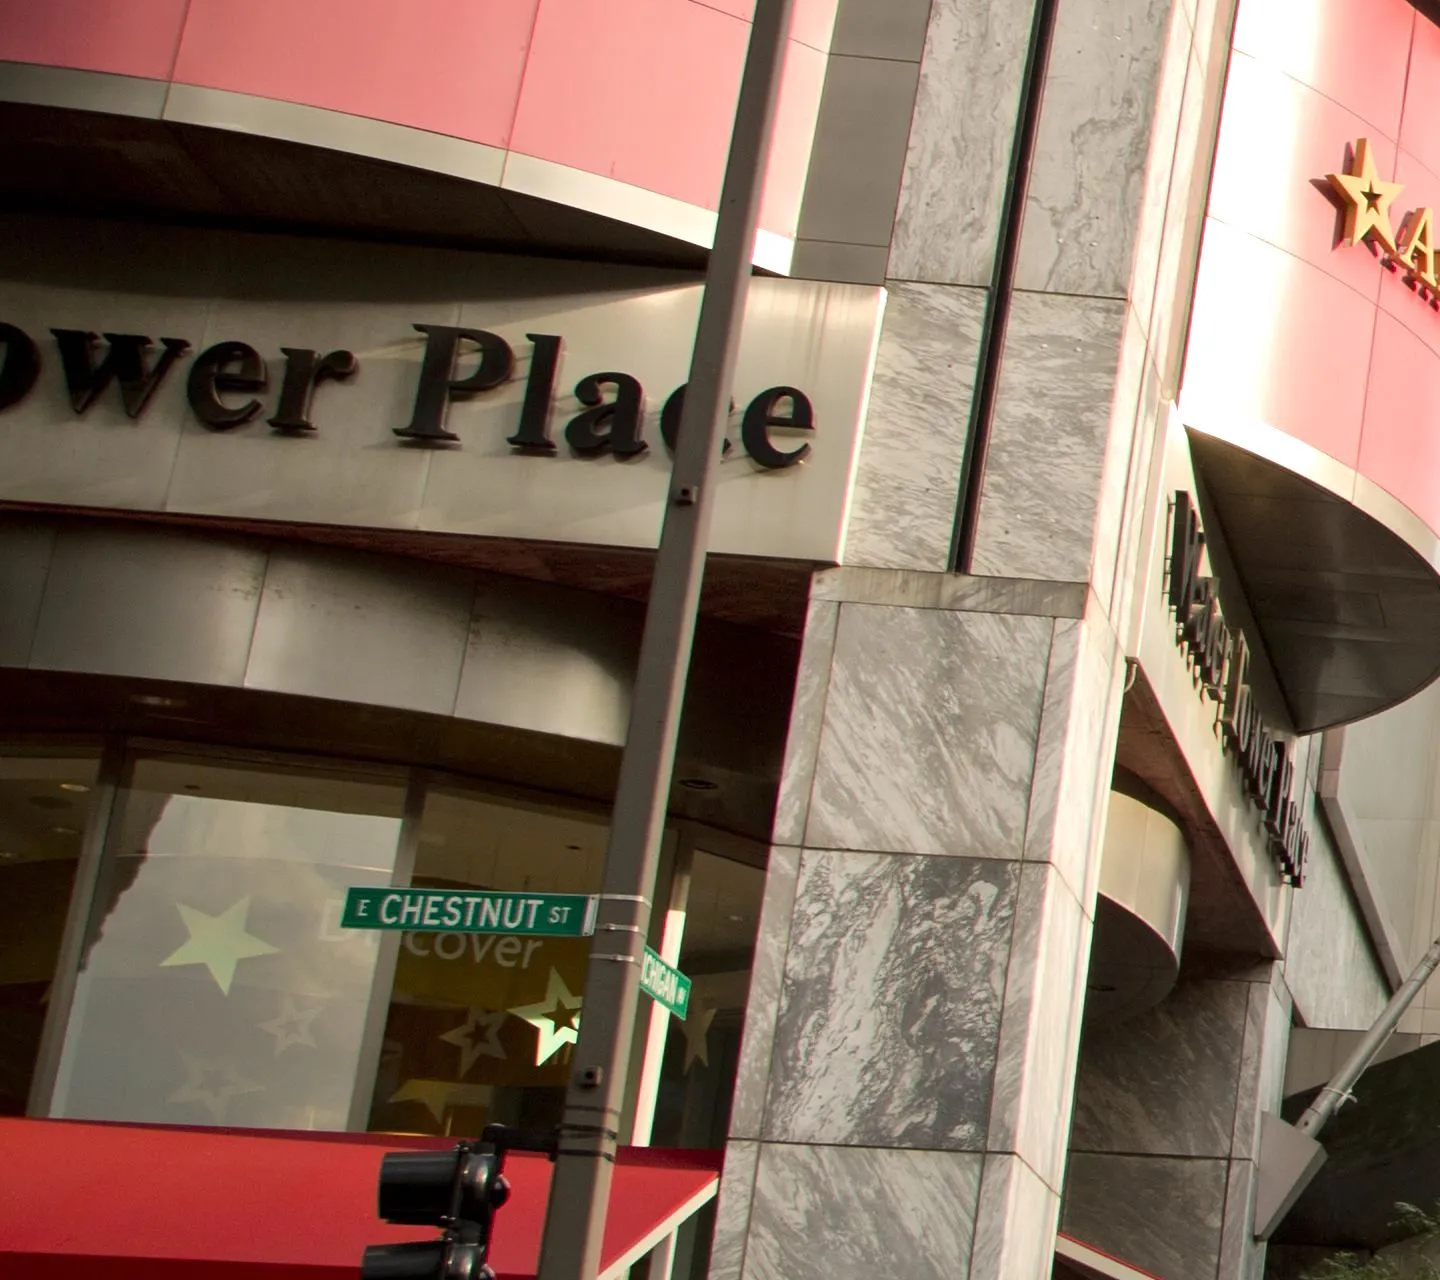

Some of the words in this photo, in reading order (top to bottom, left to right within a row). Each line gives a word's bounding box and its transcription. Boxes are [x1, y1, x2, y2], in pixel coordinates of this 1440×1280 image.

[319, 897, 544, 969] Dcover
[356, 899, 371, 917] E
[379, 893, 545, 929] CHESTNUT
[548, 905, 572, 923] ST
[641, 951, 678, 1005] ICHIGAN
